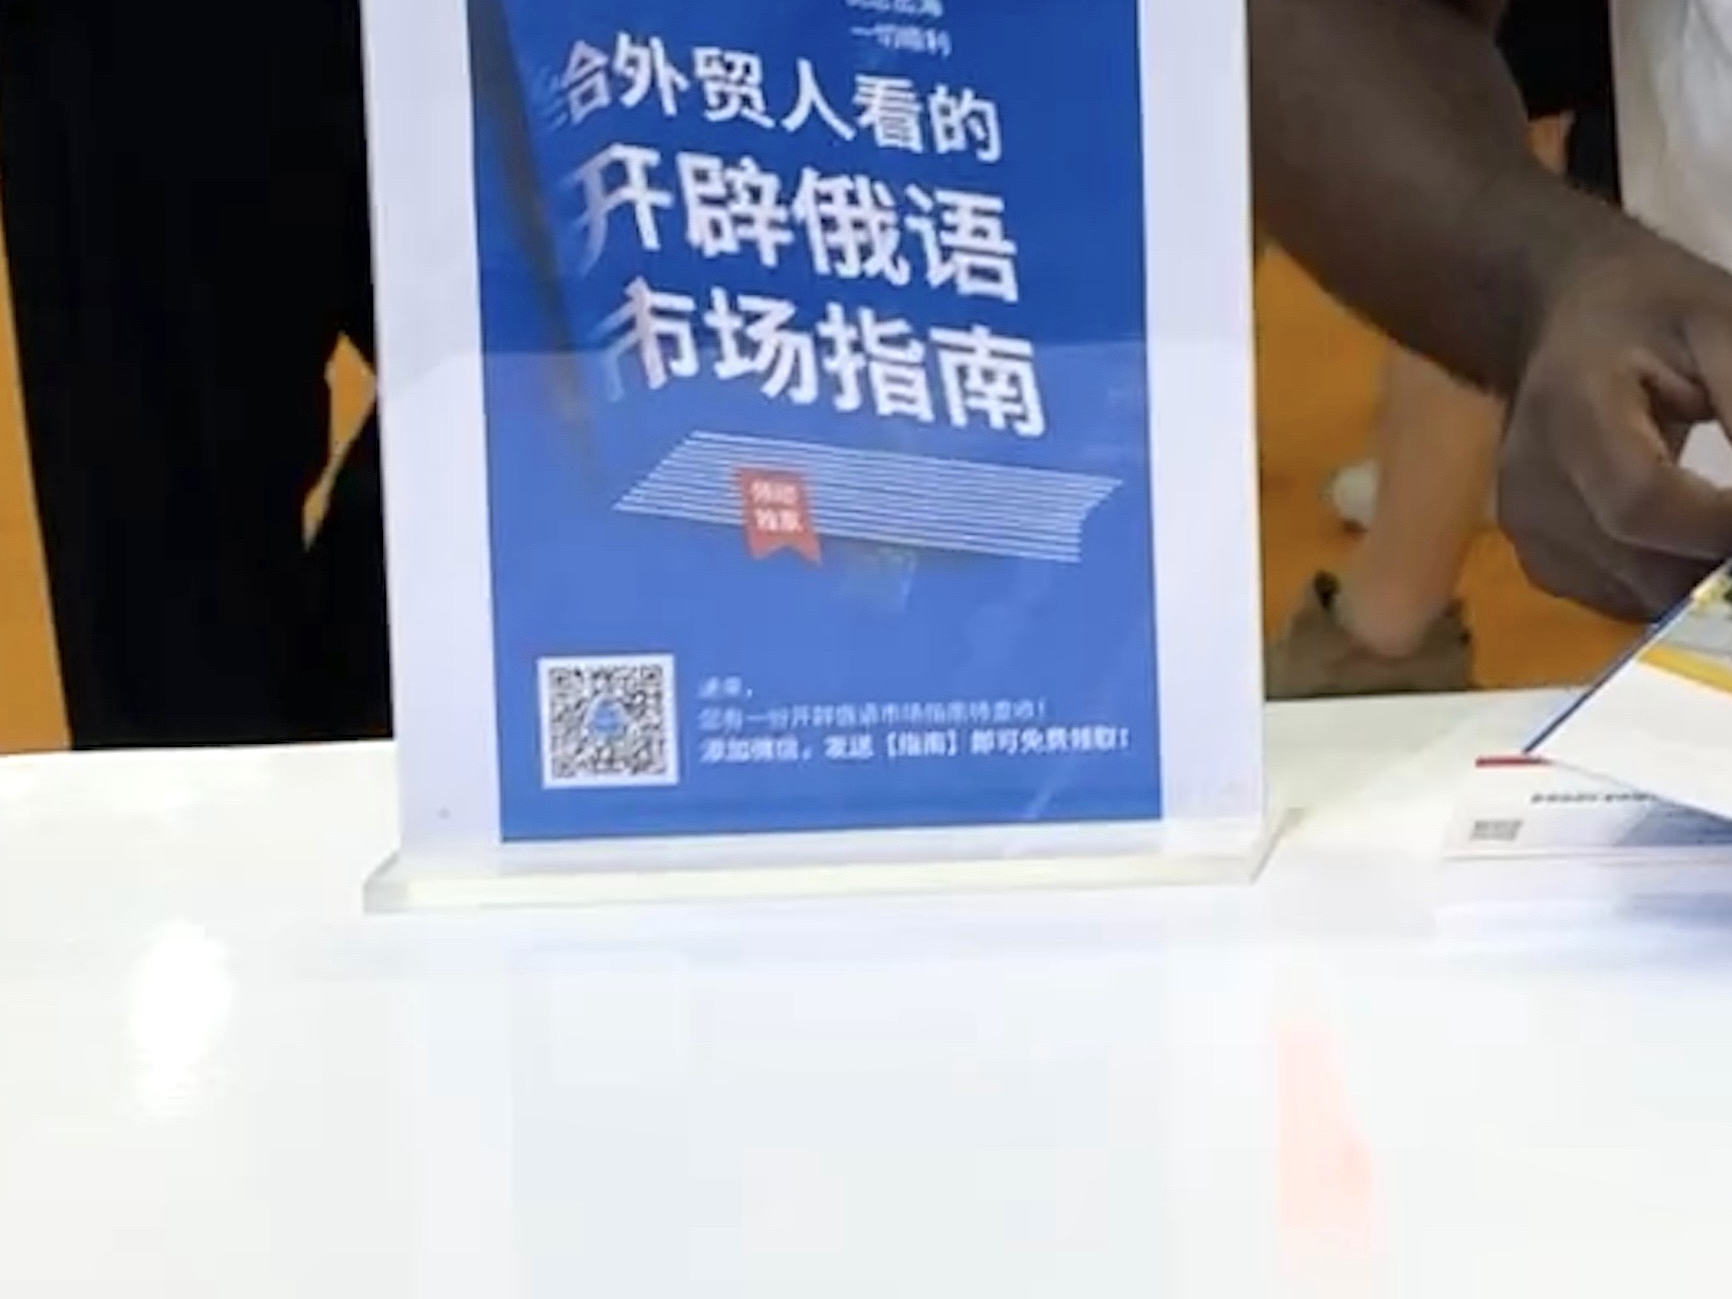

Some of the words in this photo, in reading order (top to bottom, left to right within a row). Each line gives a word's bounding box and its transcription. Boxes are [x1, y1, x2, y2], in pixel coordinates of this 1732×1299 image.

[562, 143, 1019, 303] 开辟俄语
[608, 277, 1047, 437] 市场指南
